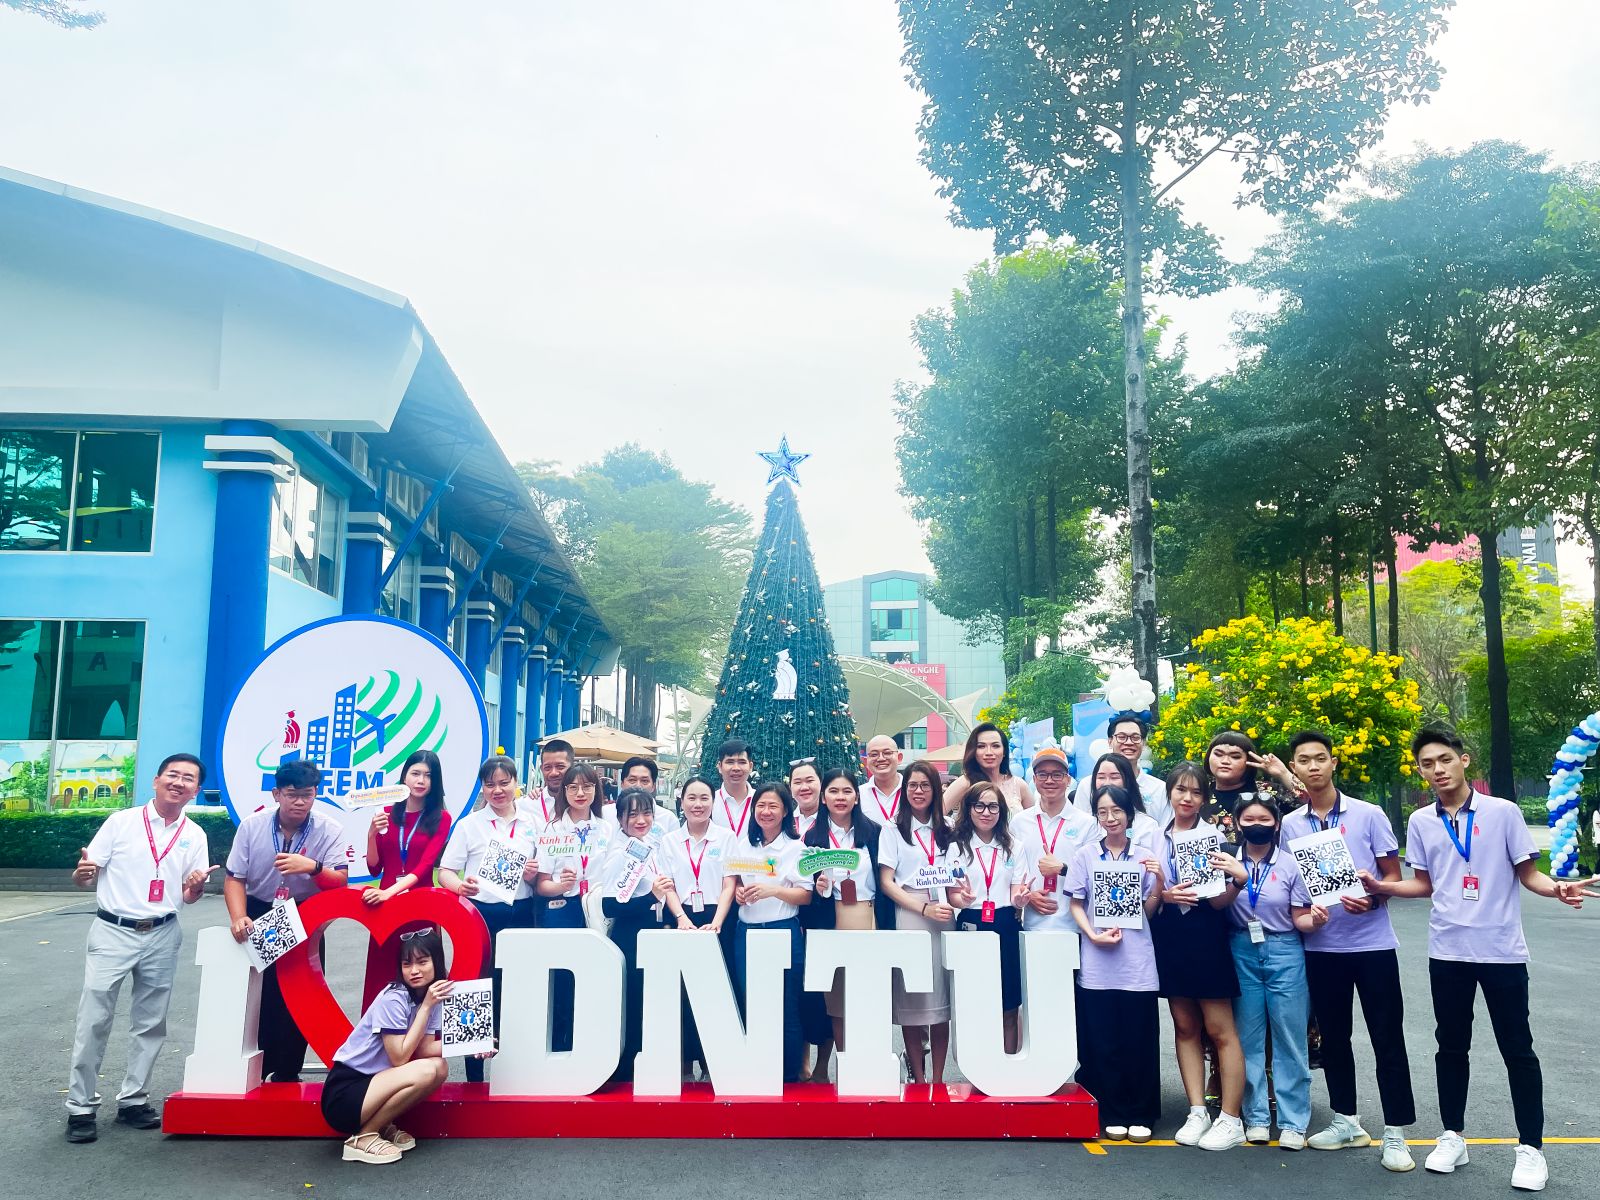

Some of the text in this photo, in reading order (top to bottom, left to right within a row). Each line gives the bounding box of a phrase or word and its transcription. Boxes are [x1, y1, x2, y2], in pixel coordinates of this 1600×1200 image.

[538, 836, 560, 845] Kinh
[916, 878, 932, 887] Kinh
[184, 927, 1080, 1096] I DNTU
